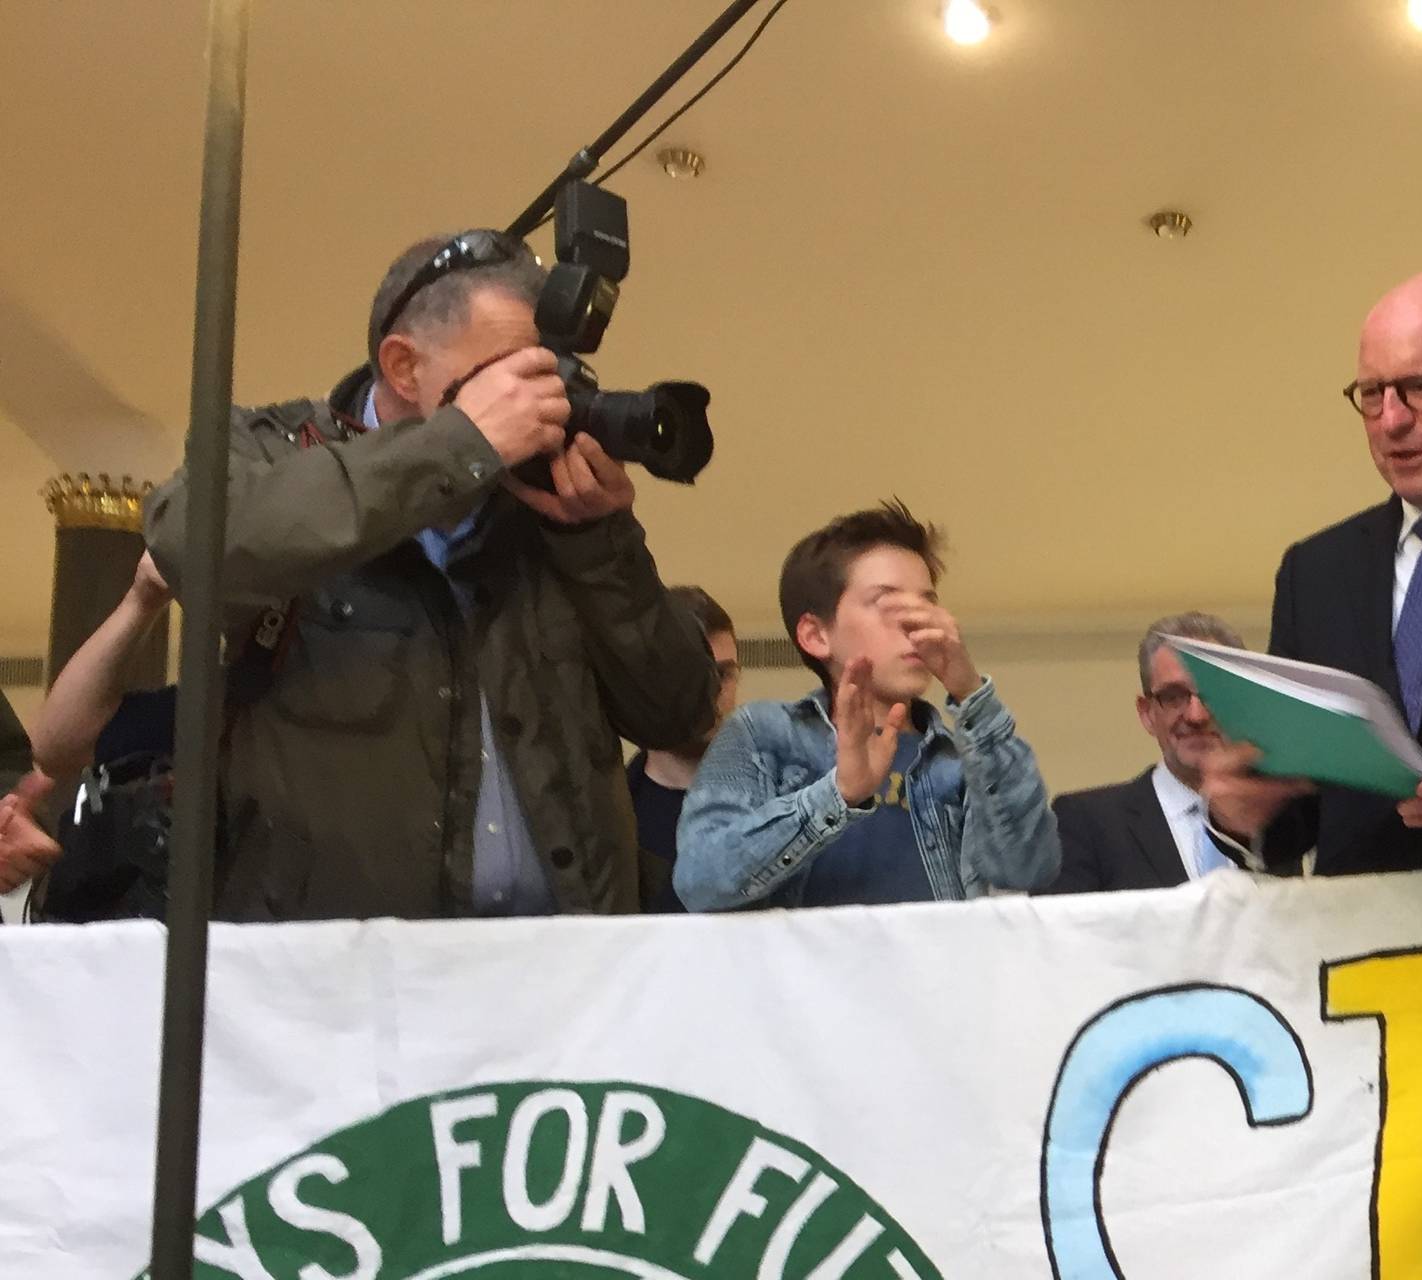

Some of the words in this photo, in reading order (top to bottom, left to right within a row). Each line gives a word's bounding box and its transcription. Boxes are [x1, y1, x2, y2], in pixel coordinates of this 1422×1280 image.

[141, 1153, 383, 1280] YS
[429, 1087, 667, 1246] FOR
[692, 1136, 924, 1280] FU
